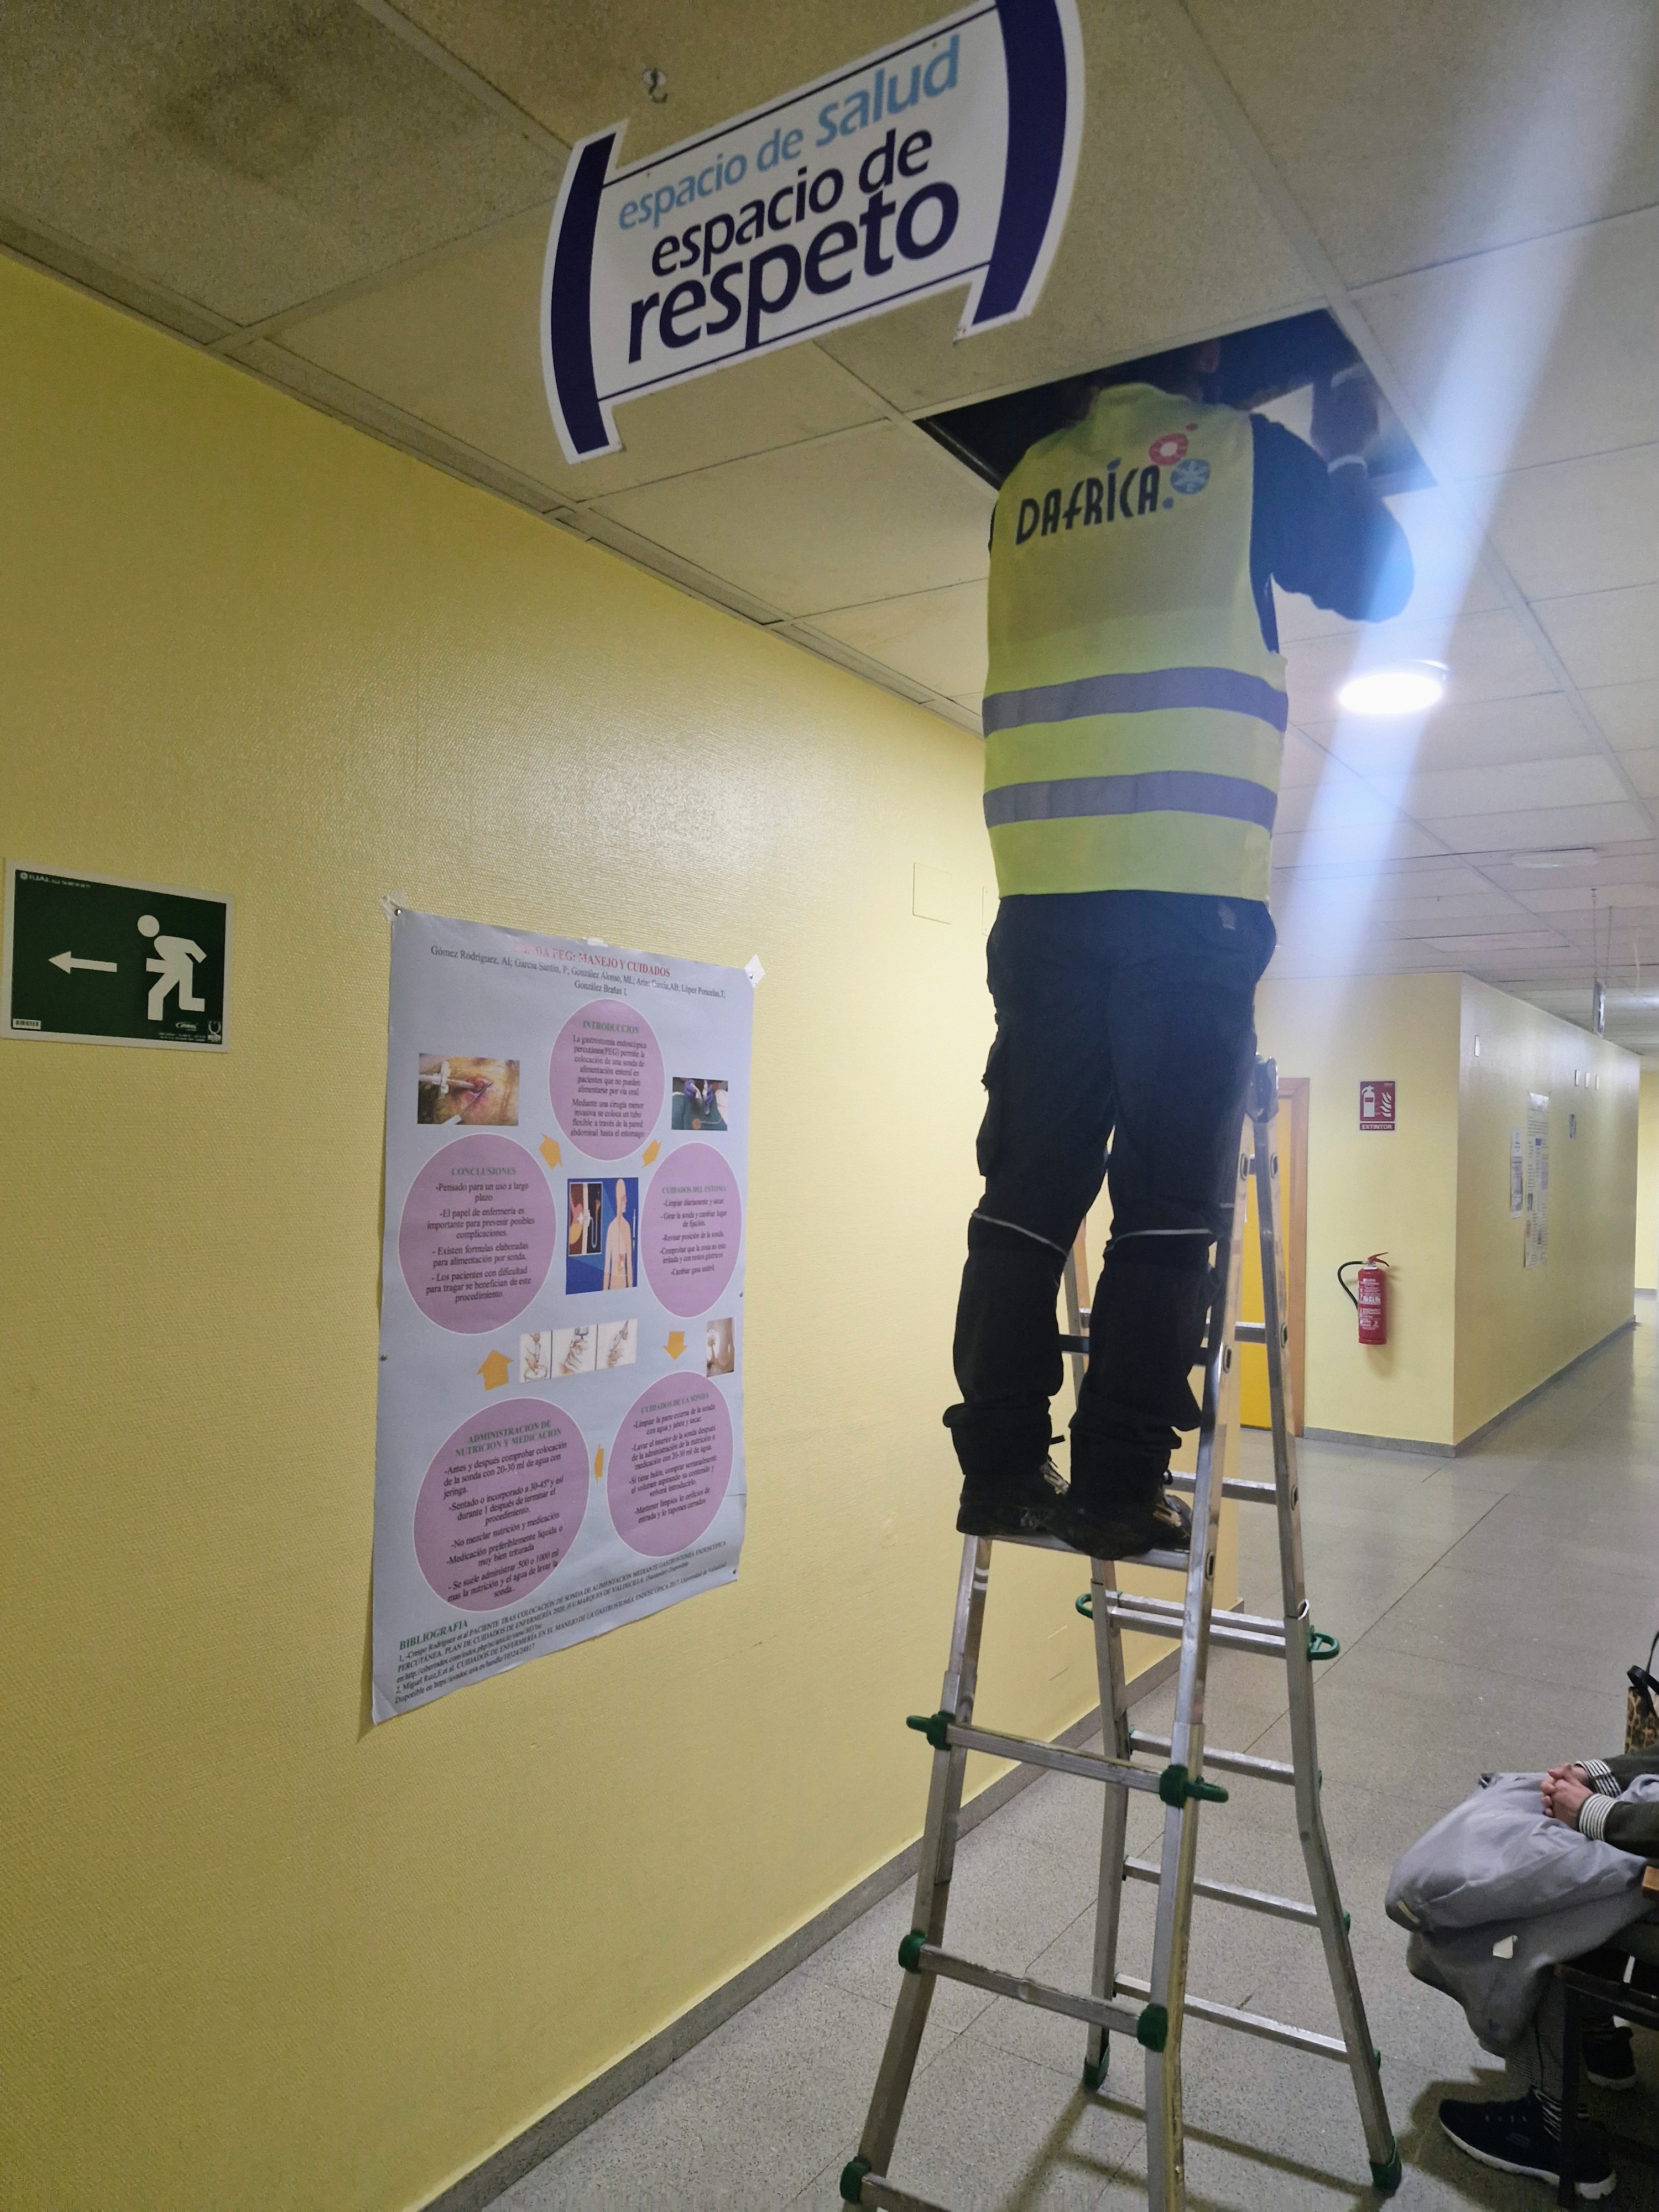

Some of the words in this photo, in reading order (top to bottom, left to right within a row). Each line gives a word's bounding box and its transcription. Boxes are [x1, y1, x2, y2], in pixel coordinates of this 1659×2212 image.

[619, 153, 747, 231] espacio
[758, 127, 803, 168] de
[816, 34, 960, 149] salud
[651, 167, 843, 276] espacio
[860, 128, 932, 193] de
[629, 181, 959, 364] respeto
[553, 947, 575, 961] PEG:
[579, 953, 618, 968] MANEJO
[620, 960, 625, 969] Y
[627, 961, 670, 977] CUIDADOS
[431, 945, 458, 958] Gómez
[681, 984, 697, 995] López
[575, 980, 602, 992] González
[580, 1066, 613, 1074] alimentación
[575, 1108, 596, 1117] invasiva
[514, 1182, 528, 1192] largo
[475, 1193, 493, 1203] plazo
[453, 1208, 470, 1219] papel
[427, 1220, 464, 1232] importante
[466, 1221, 481, 1230] para
[482, 1219, 508, 1228] prevenir
[510, 1217, 535, 1227] posibles
[437, 1246, 462, 1255] Existen
[495, 1241, 528, 1251] elaboradas
[434, 1259, 448, 1269] para
[450, 1255, 492, 1265] alimentación
[494, 1255, 505, 1264] por
[437, 1273, 449, 1281] Los
[452, 1271, 482, 1282] pacientes
[498, 1266, 528, 1276] dificultad
[426, 1287, 441, 1296] para
[444, 1283, 463, 1293] tragar
[474, 1279, 508, 1289] benefician
[502, 1449, 535, 1465] comprobar
[536, 1441, 567, 1455] colocación
[444, 1478, 452, 1486] de
[454, 1475, 460, 1484] la
[462, 1470, 481, 1483] sonda
[483, 1470, 495, 1480] con
[497, 1463, 515, 1475] 20-30
[517, 1460, 525, 1469] ml
[527, 1459, 534, 1467] de
[535, 1456, 549, 1467] agua
[551, 1453, 561, 1462] con
[487, 1486, 523, 1502] incorporado
[466, 1532, 491, 1545] mezclar
[478, 1558, 492, 1567] muy
[494, 1553, 507, 1562] bien
